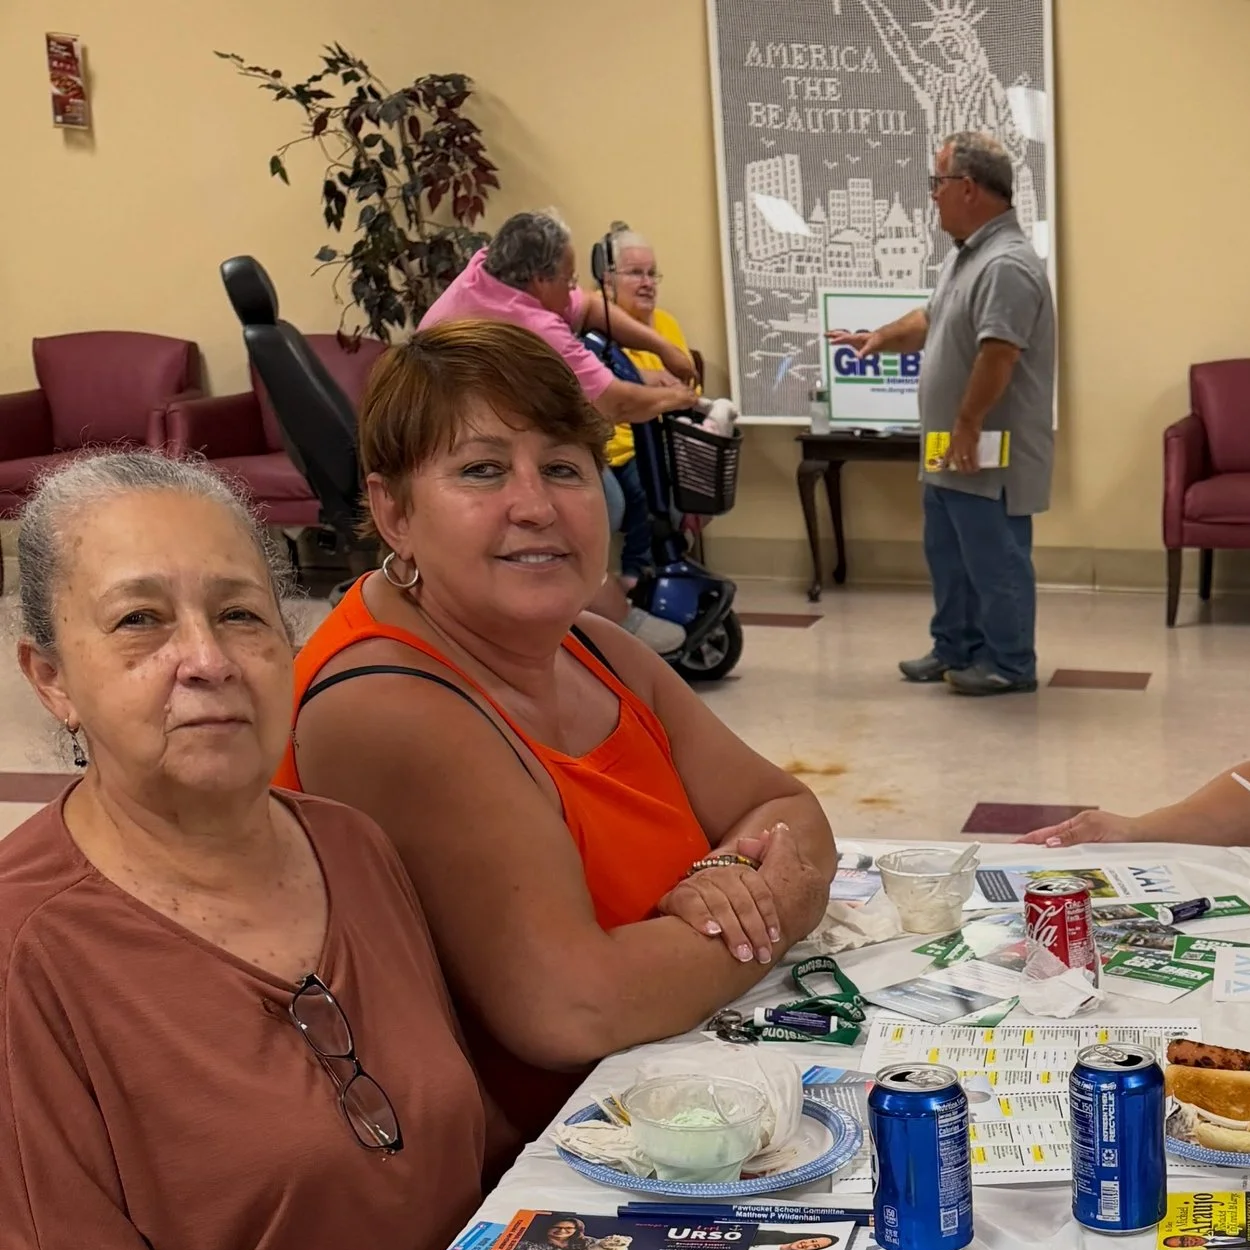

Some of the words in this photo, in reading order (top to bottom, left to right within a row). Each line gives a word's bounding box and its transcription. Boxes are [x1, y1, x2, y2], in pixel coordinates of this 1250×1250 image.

[744, 40, 882, 73] AMERICA
[782, 76, 841, 101] THE
[748, 101, 916, 135] BEAUTIFUL
[834, 347, 921, 376] GREB
[736, 1211, 768, 1219] Matthew
[777, 1212, 821, 1221] Wildenhain
[1179, 1193, 1224, 1232] Araujo
[665, 1227, 742, 1242] URSO
